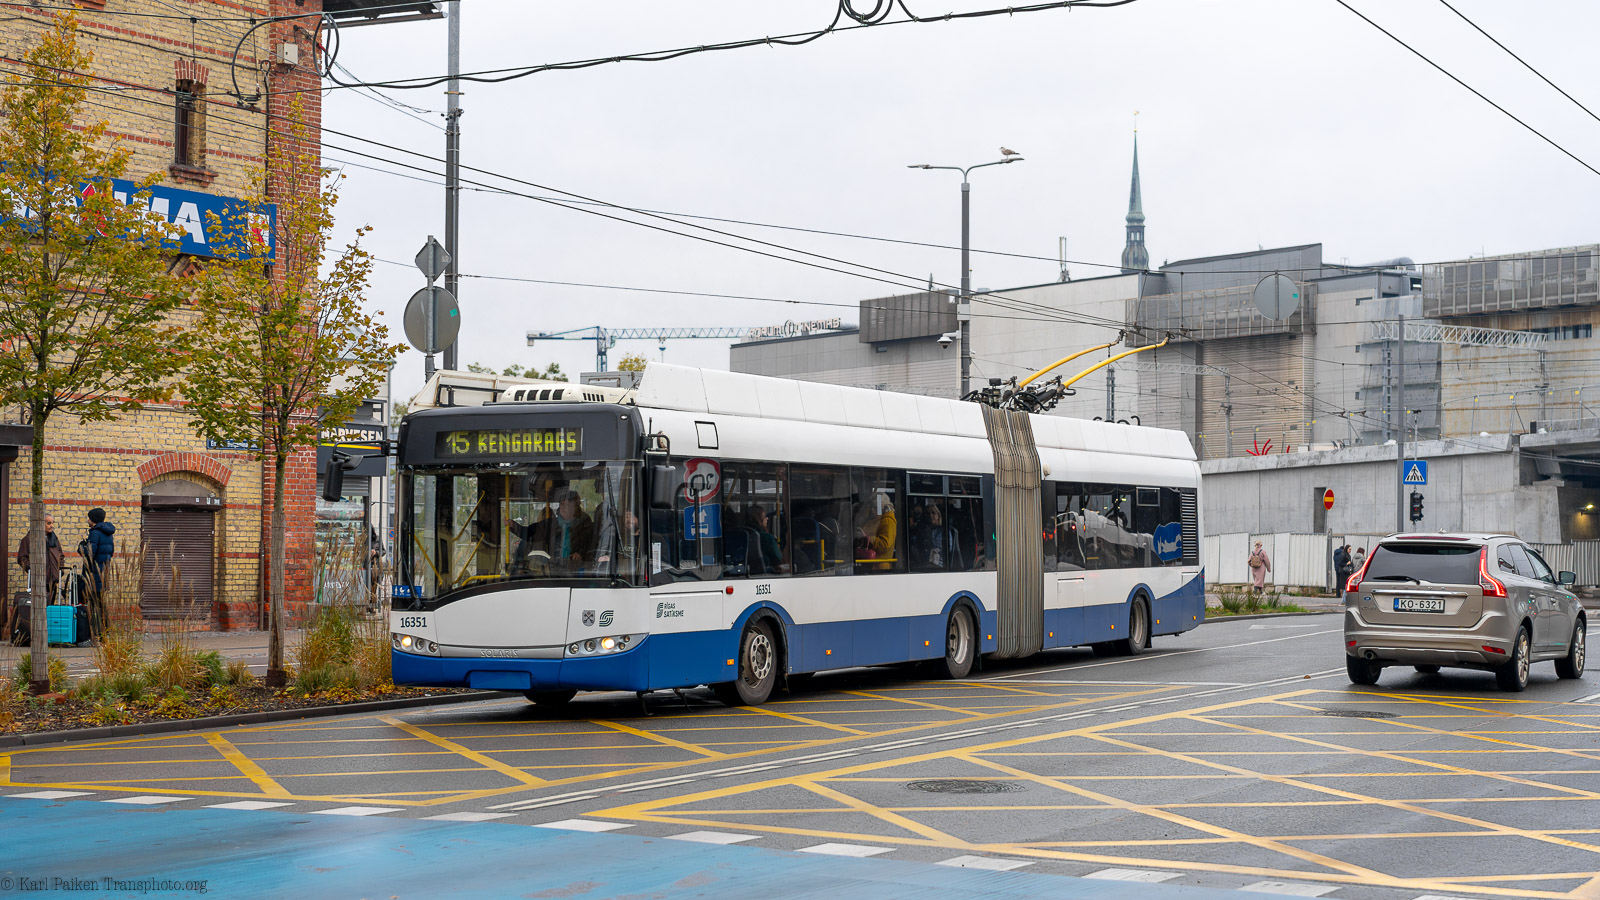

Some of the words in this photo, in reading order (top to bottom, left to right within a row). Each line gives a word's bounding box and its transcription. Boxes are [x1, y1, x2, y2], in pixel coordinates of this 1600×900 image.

[446, 431, 470, 454] 15
[755, 583, 771, 595] 16351
[1400, 600, 1442, 610] KO-6321
[400, 616, 428, 628] 16351
[480, 649, 519, 658] SOLARIS
